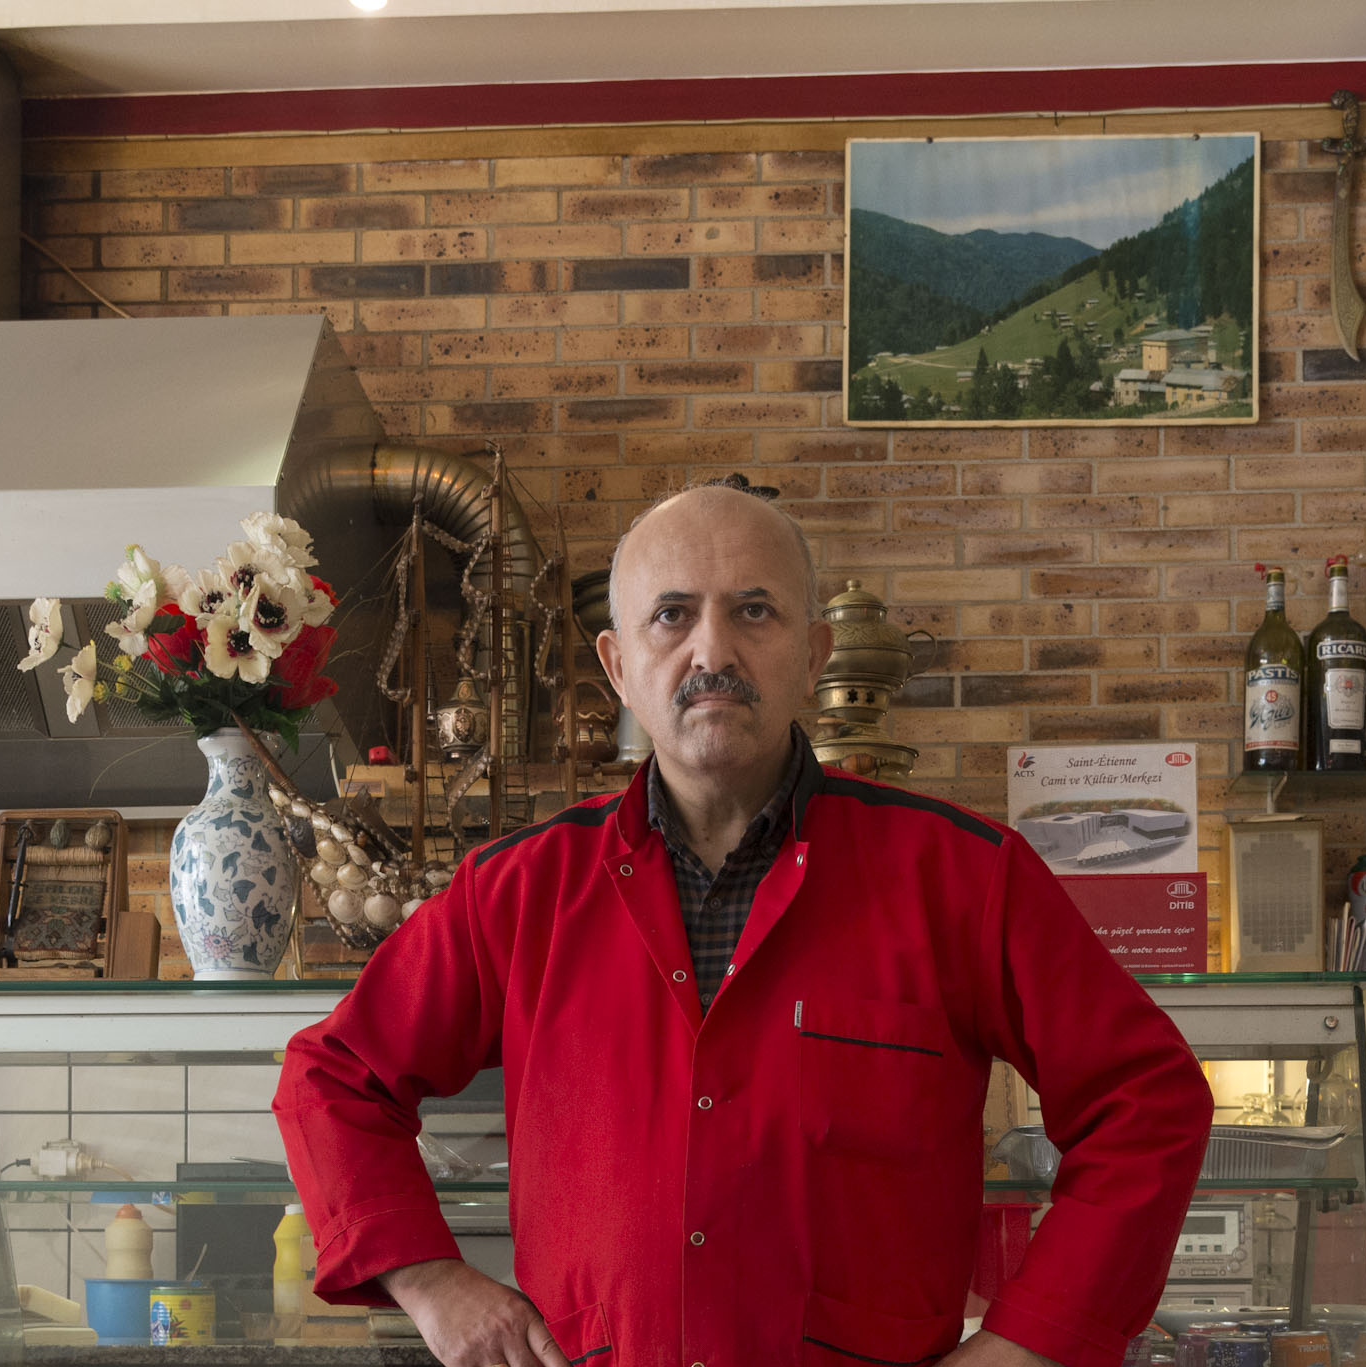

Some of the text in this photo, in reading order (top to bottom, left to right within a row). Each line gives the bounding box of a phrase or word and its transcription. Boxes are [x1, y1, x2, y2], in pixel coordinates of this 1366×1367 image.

[1248, 667, 1298, 680] PASTIS
[1066, 754, 1139, 769] Saint-Étienne
[1013, 770, 1036, 778] ACTS
[1040, 771, 1163, 788] Cami ve Kültür Merkezi
[1110, 927, 1134, 937] güzel
[1132, 945, 1154, 954] notre
